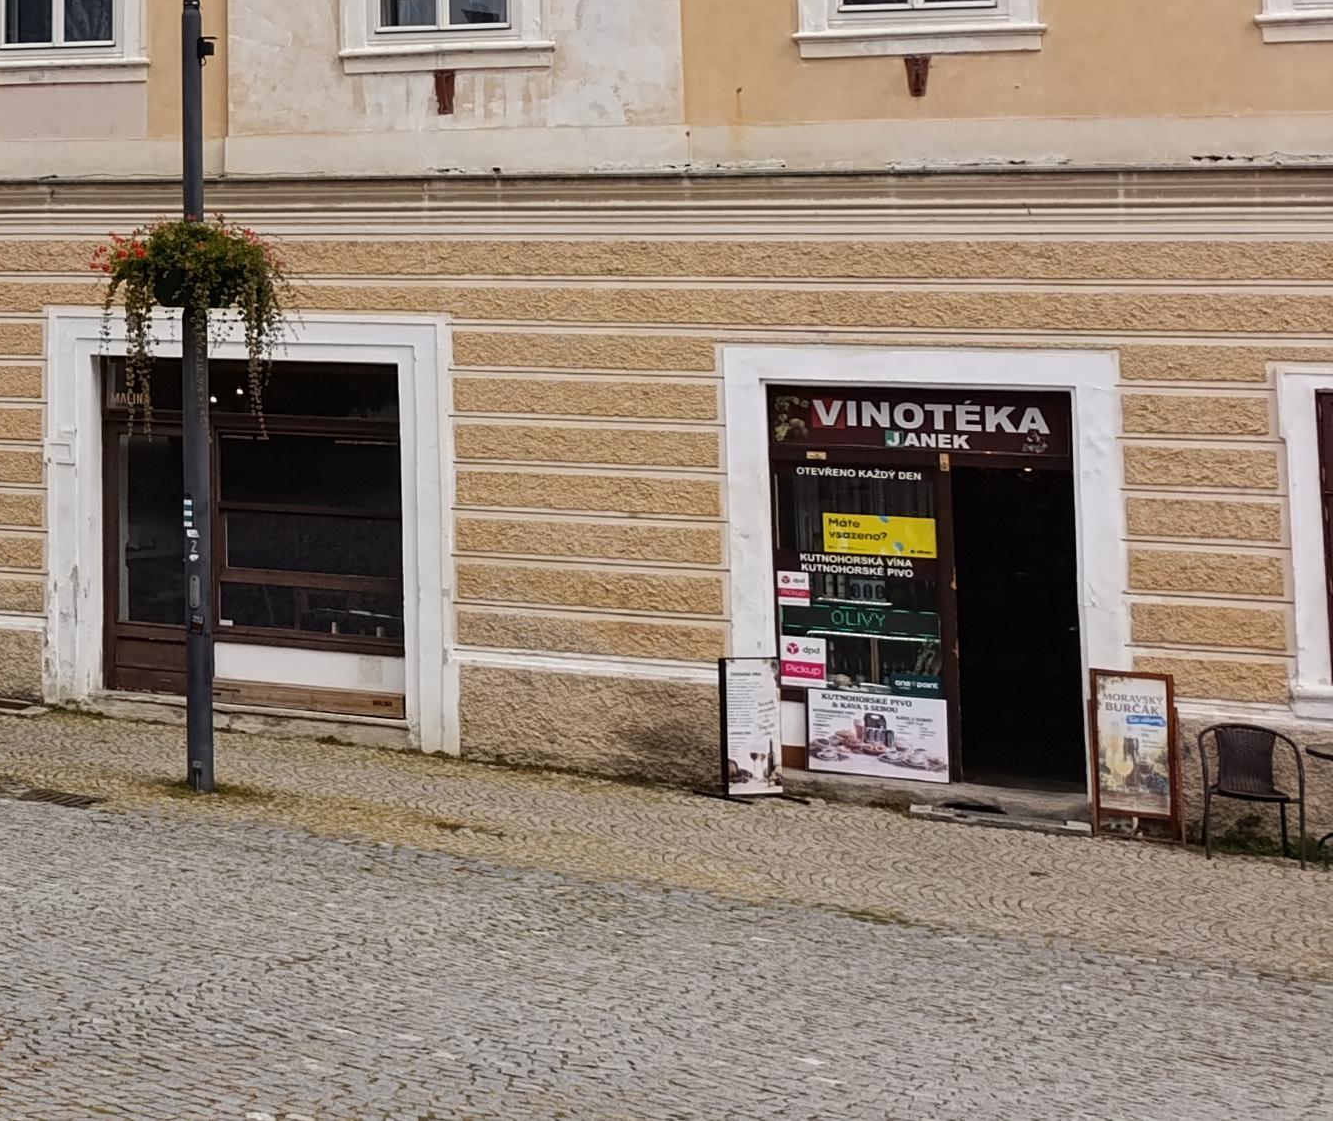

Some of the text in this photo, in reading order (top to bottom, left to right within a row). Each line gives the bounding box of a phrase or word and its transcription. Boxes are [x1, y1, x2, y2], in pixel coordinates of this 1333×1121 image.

[812, 399, 1051, 435] VINOTÉKA
[886, 432, 971, 450] JANEK
[796, 465, 922, 481] OTEVŘENO KAŽDÝ DEN
[828, 517, 860, 528] Máte
[828, 531, 887, 541] vsazeno?
[190, 540, 197, 553] 2
[799, 553, 913, 567] KUTNOHORSKÁ VÍNA
[801, 563, 914, 578] KUTNOHORSKÉ PIVO
[831, 610, 886, 627] OLIVY
[803, 644, 820, 655] dpd
[785, 664, 822, 676] Pickup
[890, 699, 913, 707] PIVO
[1102, 692, 1163, 705] MORAVSKÝ
[1105, 702, 1160, 715] BURČÁK
